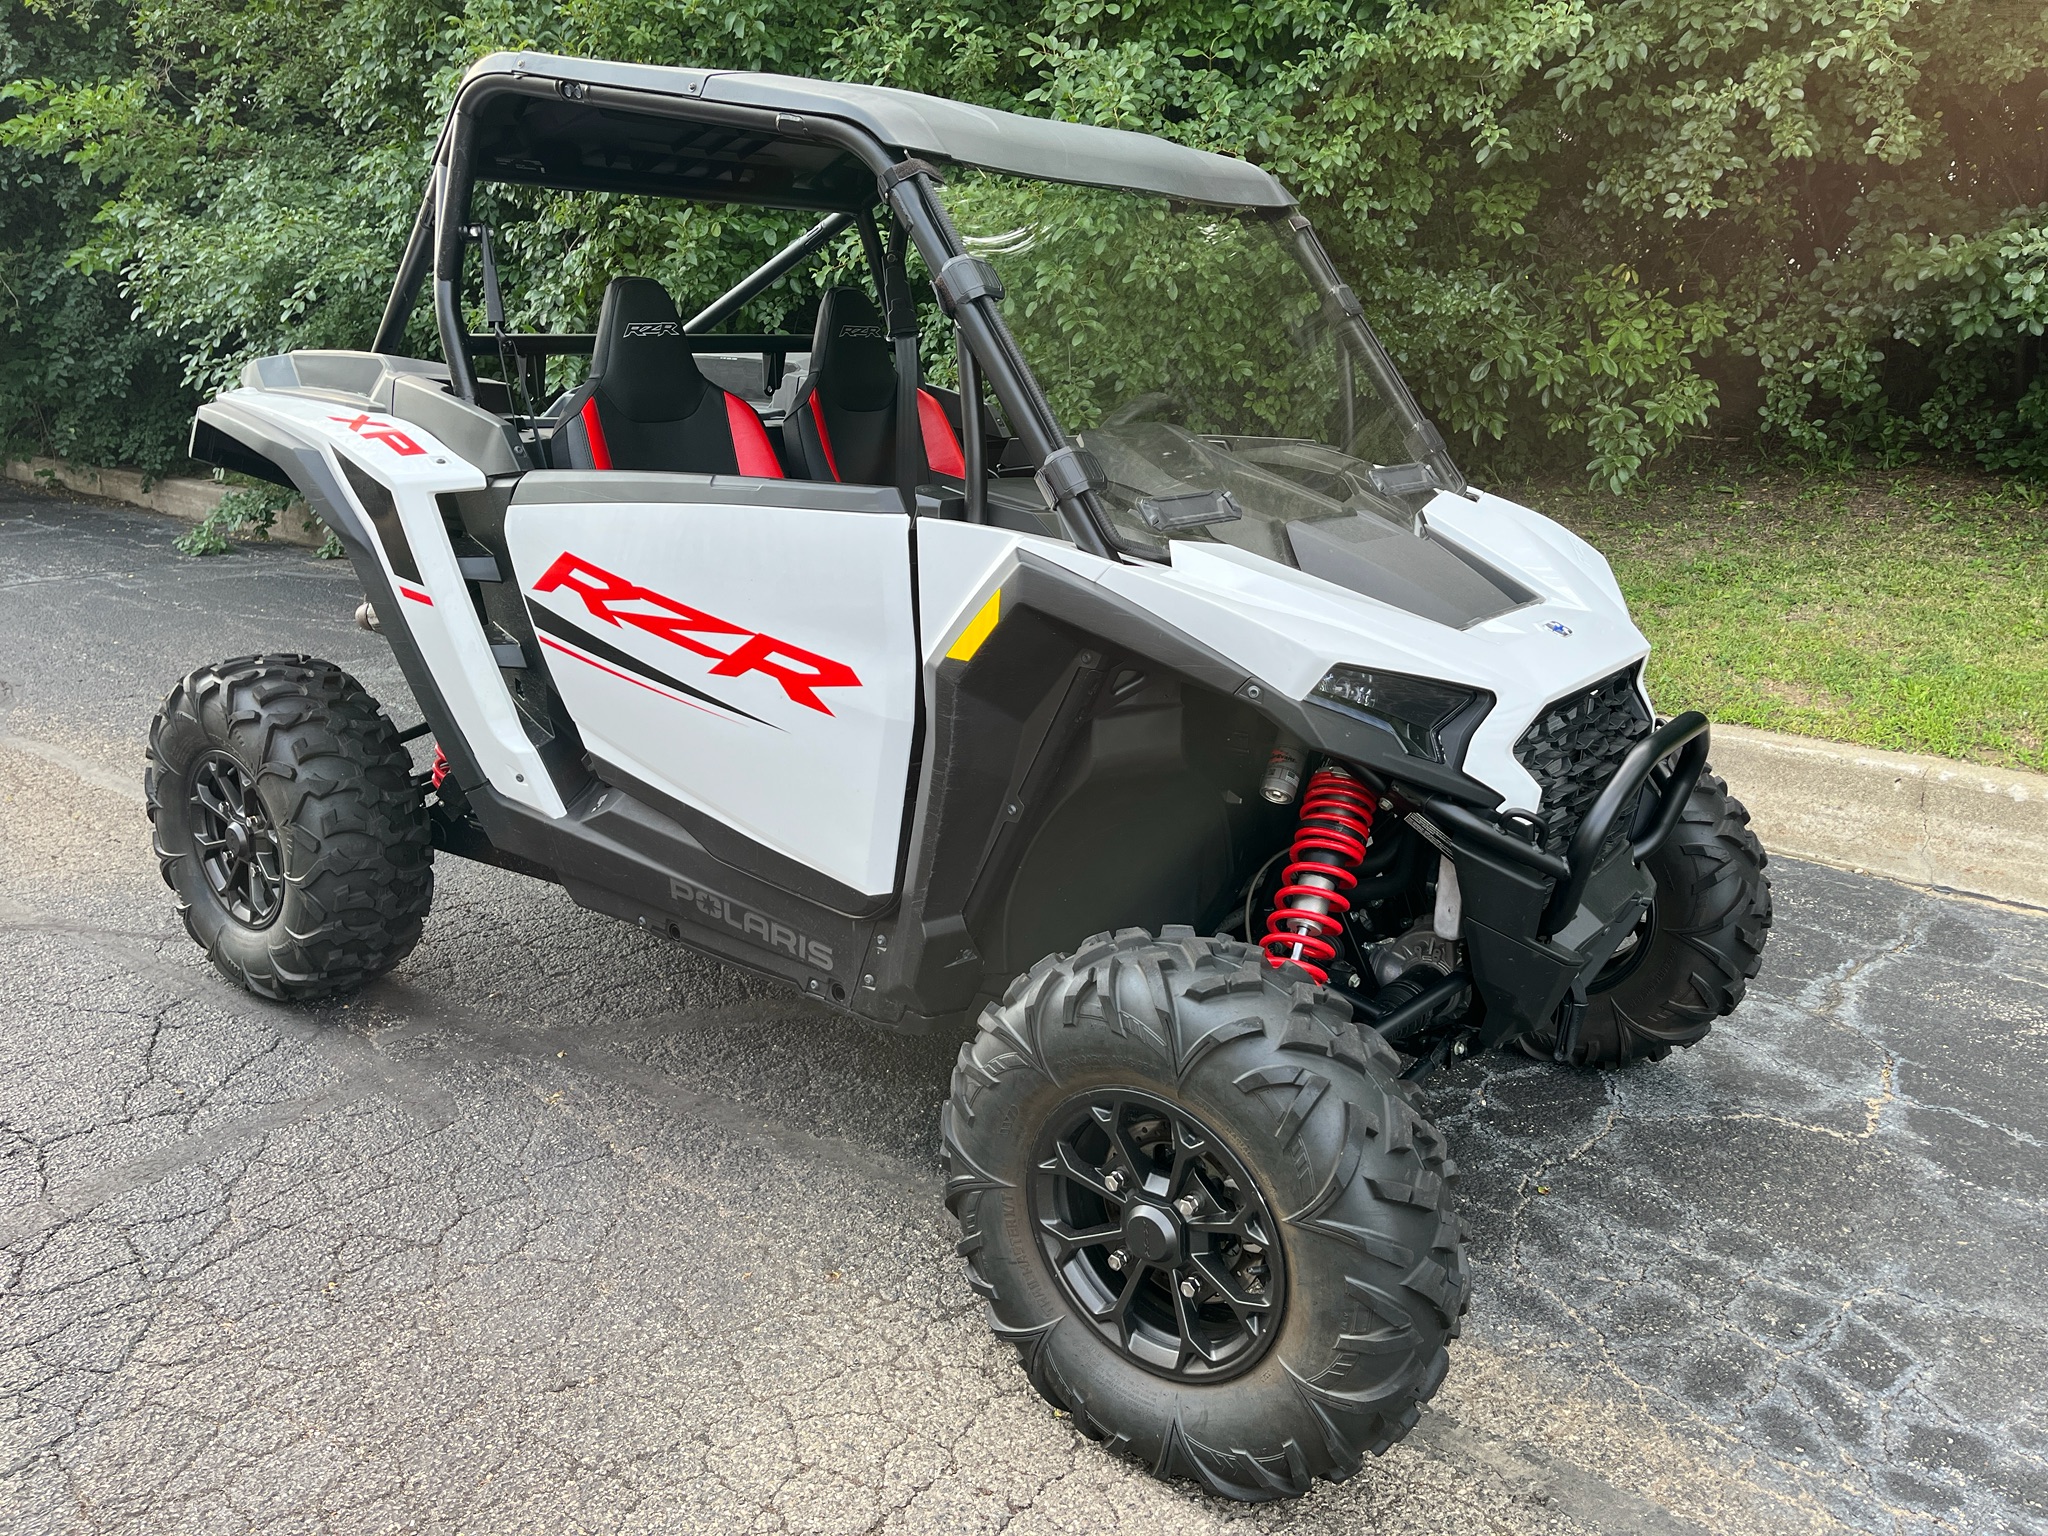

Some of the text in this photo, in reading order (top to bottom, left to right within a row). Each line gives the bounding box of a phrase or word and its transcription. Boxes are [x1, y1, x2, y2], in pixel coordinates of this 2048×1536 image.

[623, 322, 680, 338] RZR
[838, 324, 881, 338] RZR
[325, 414, 428, 456] XP
[531, 551, 864, 718] RZR
[669, 877, 834, 971] POLARIS
